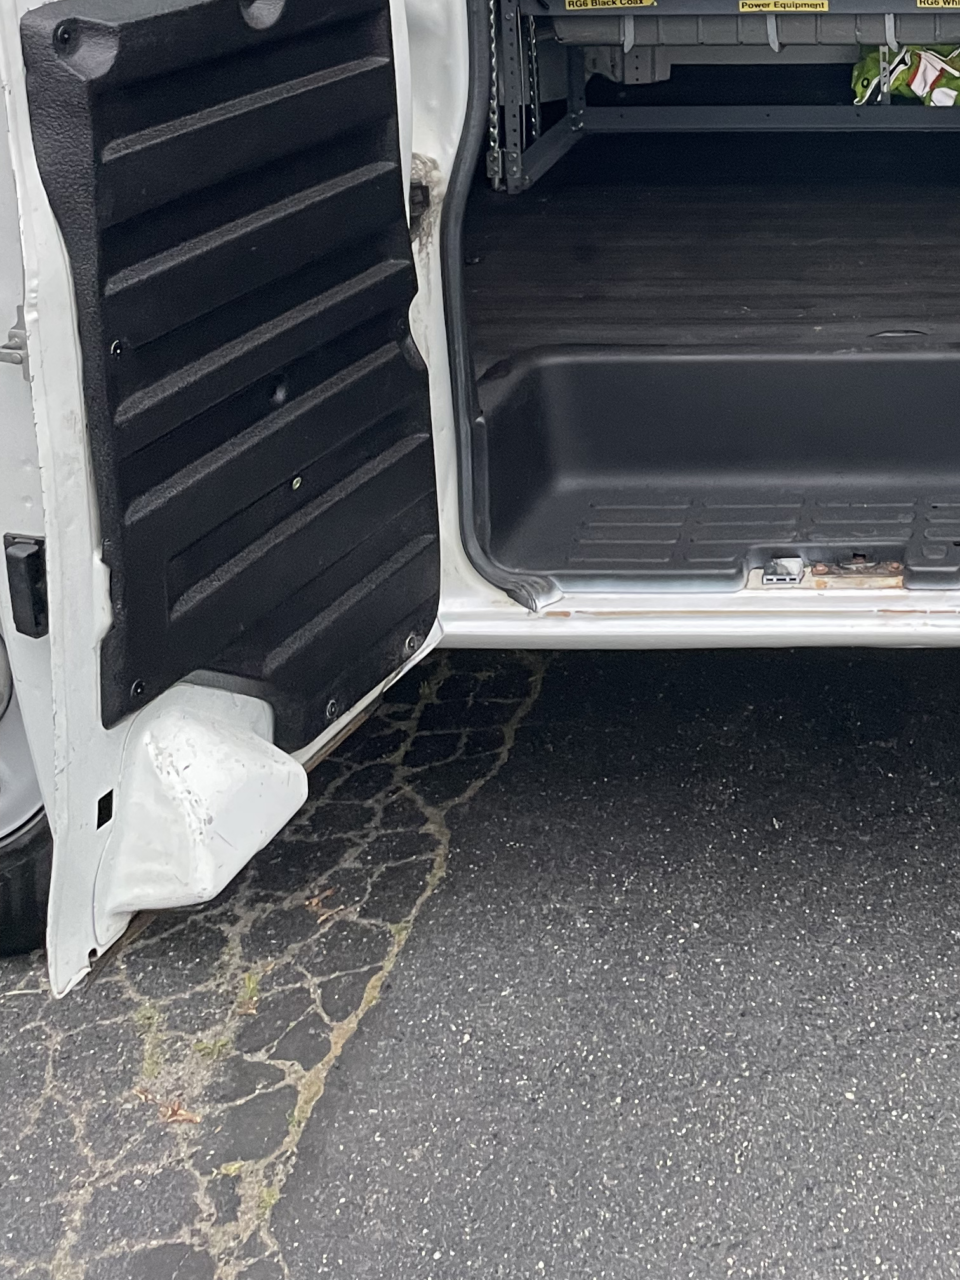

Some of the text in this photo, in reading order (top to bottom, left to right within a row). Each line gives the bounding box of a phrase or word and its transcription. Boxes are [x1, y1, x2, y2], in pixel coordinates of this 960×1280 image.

[568, 0, 589, 9] RG6
[741, 1, 825, 10] Power Equipment
